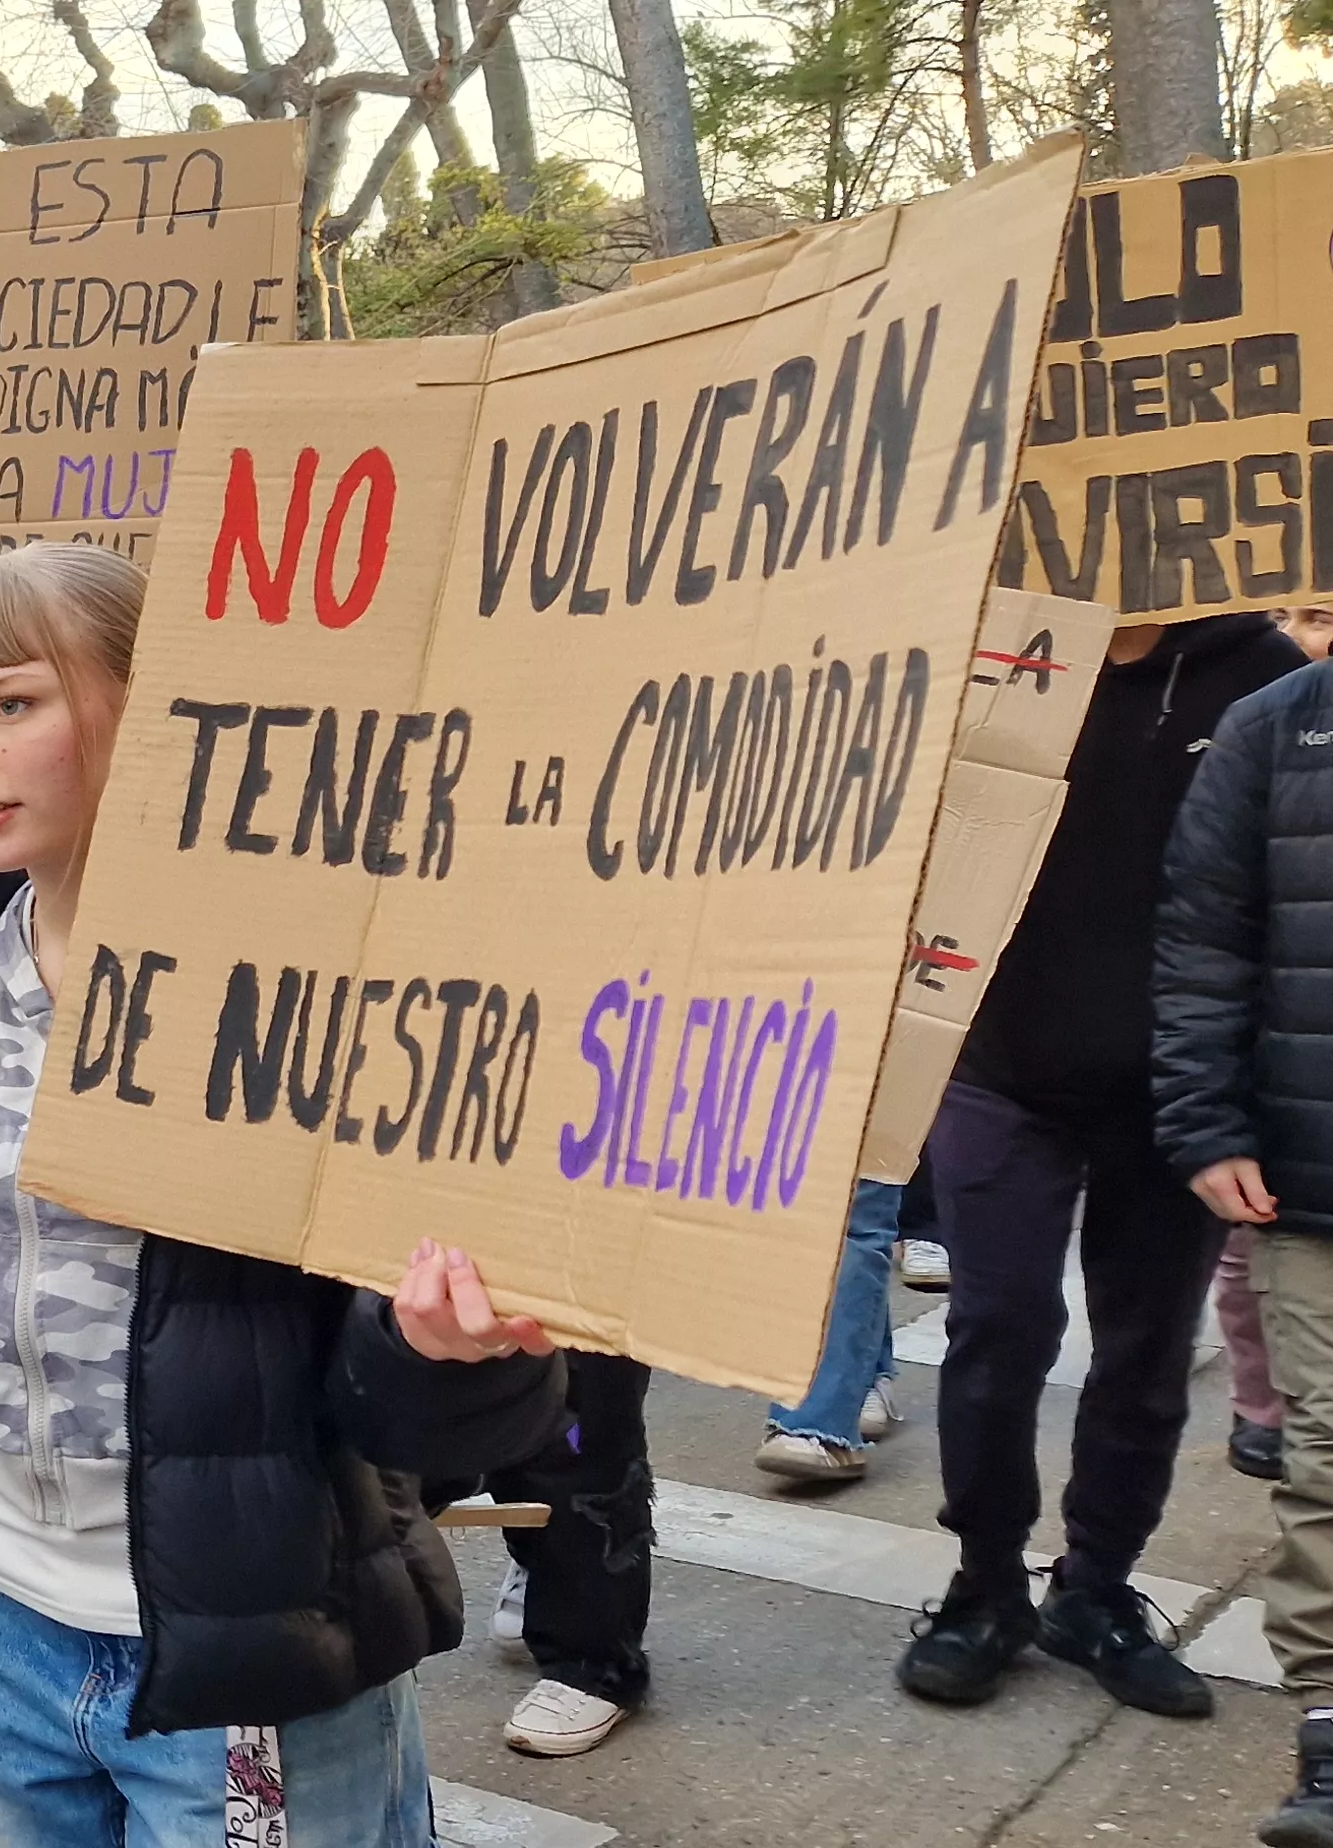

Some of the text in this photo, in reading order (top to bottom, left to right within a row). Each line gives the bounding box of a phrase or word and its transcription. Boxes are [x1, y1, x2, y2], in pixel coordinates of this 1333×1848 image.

[28, 148, 223, 246] ESTA
[205, 278, 1019, 630] NO VOLVERÁN A
[169, 696, 471, 880] TENER
[505, 755, 566, 826] LA
[69, 943, 178, 1107] DE
[204, 960, 541, 1166] NUESTRO
